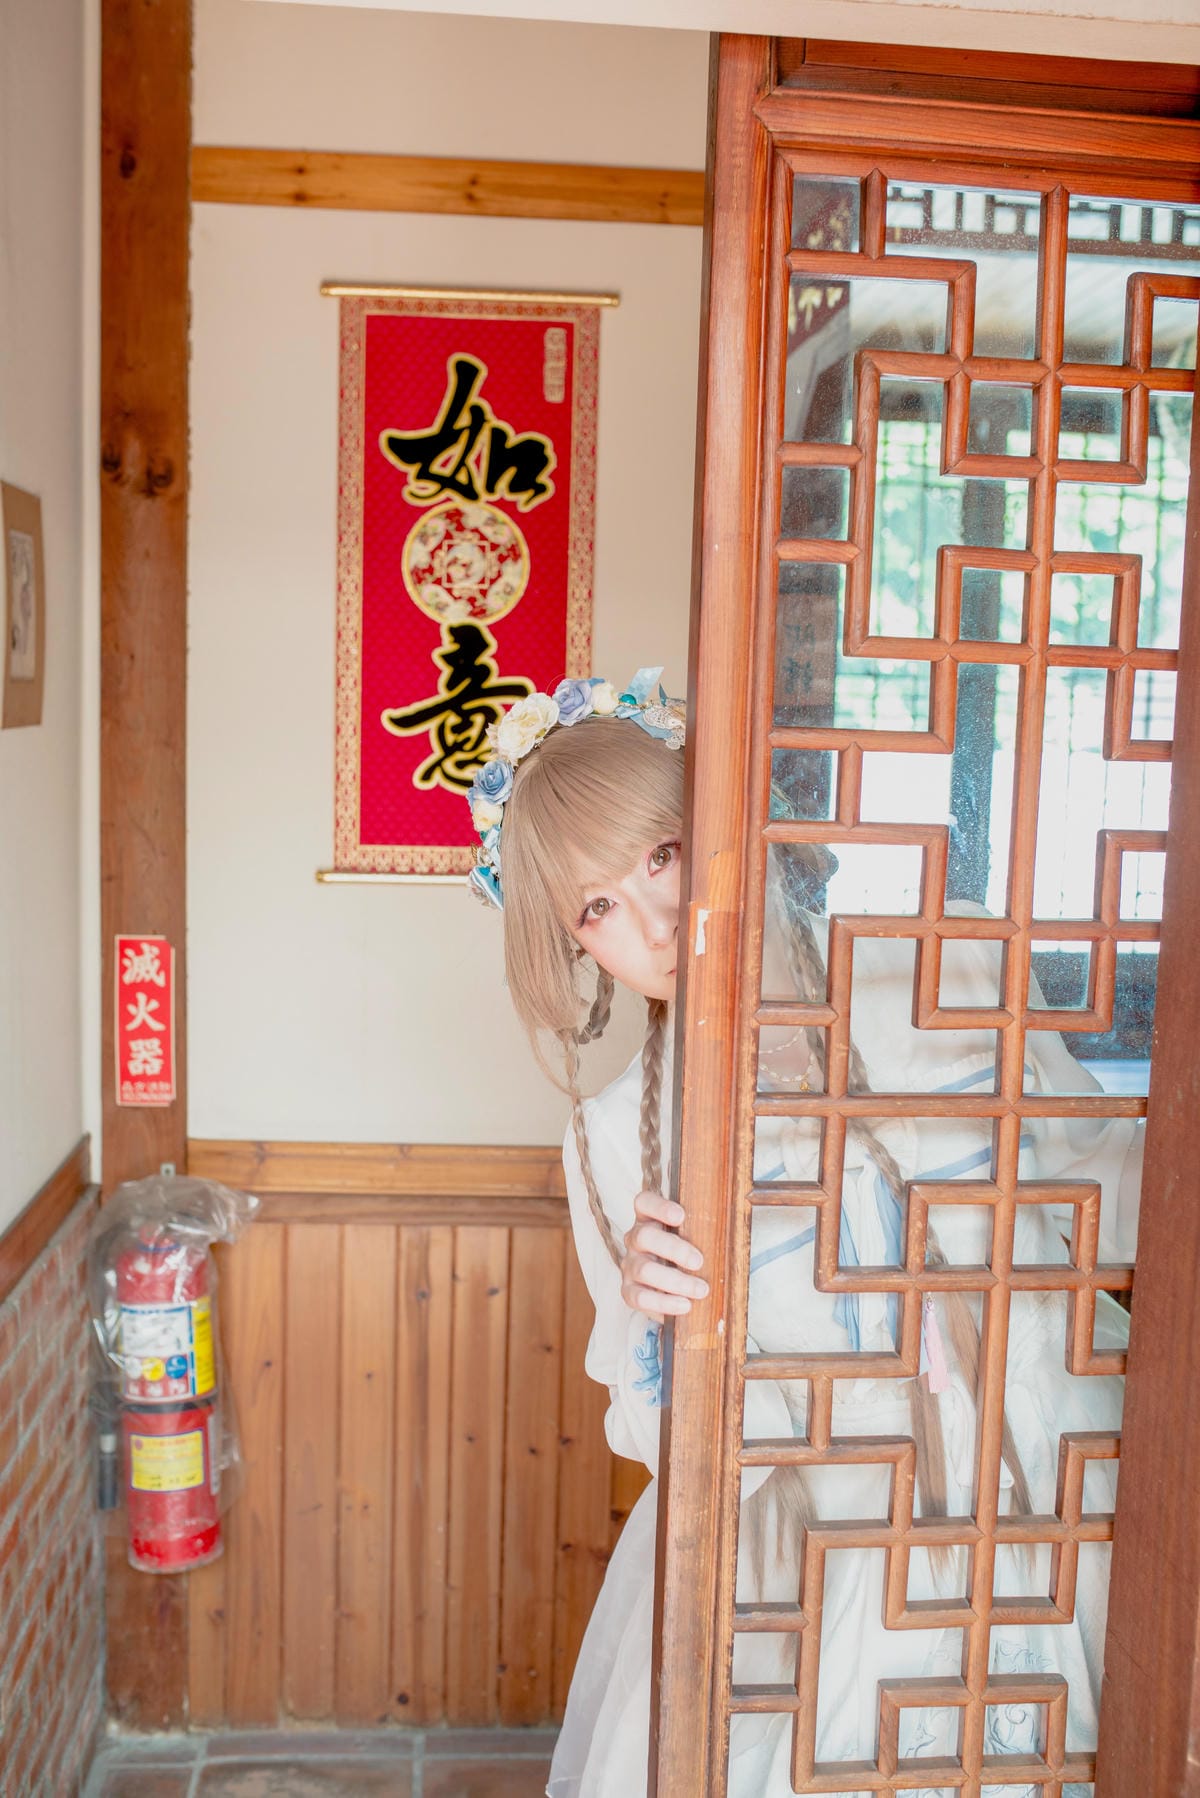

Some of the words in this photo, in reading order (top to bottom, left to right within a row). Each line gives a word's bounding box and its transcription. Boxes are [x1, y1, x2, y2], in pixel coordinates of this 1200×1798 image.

[379, 352, 556, 791] 如意
[121, 942, 167, 1077] 滅火器
